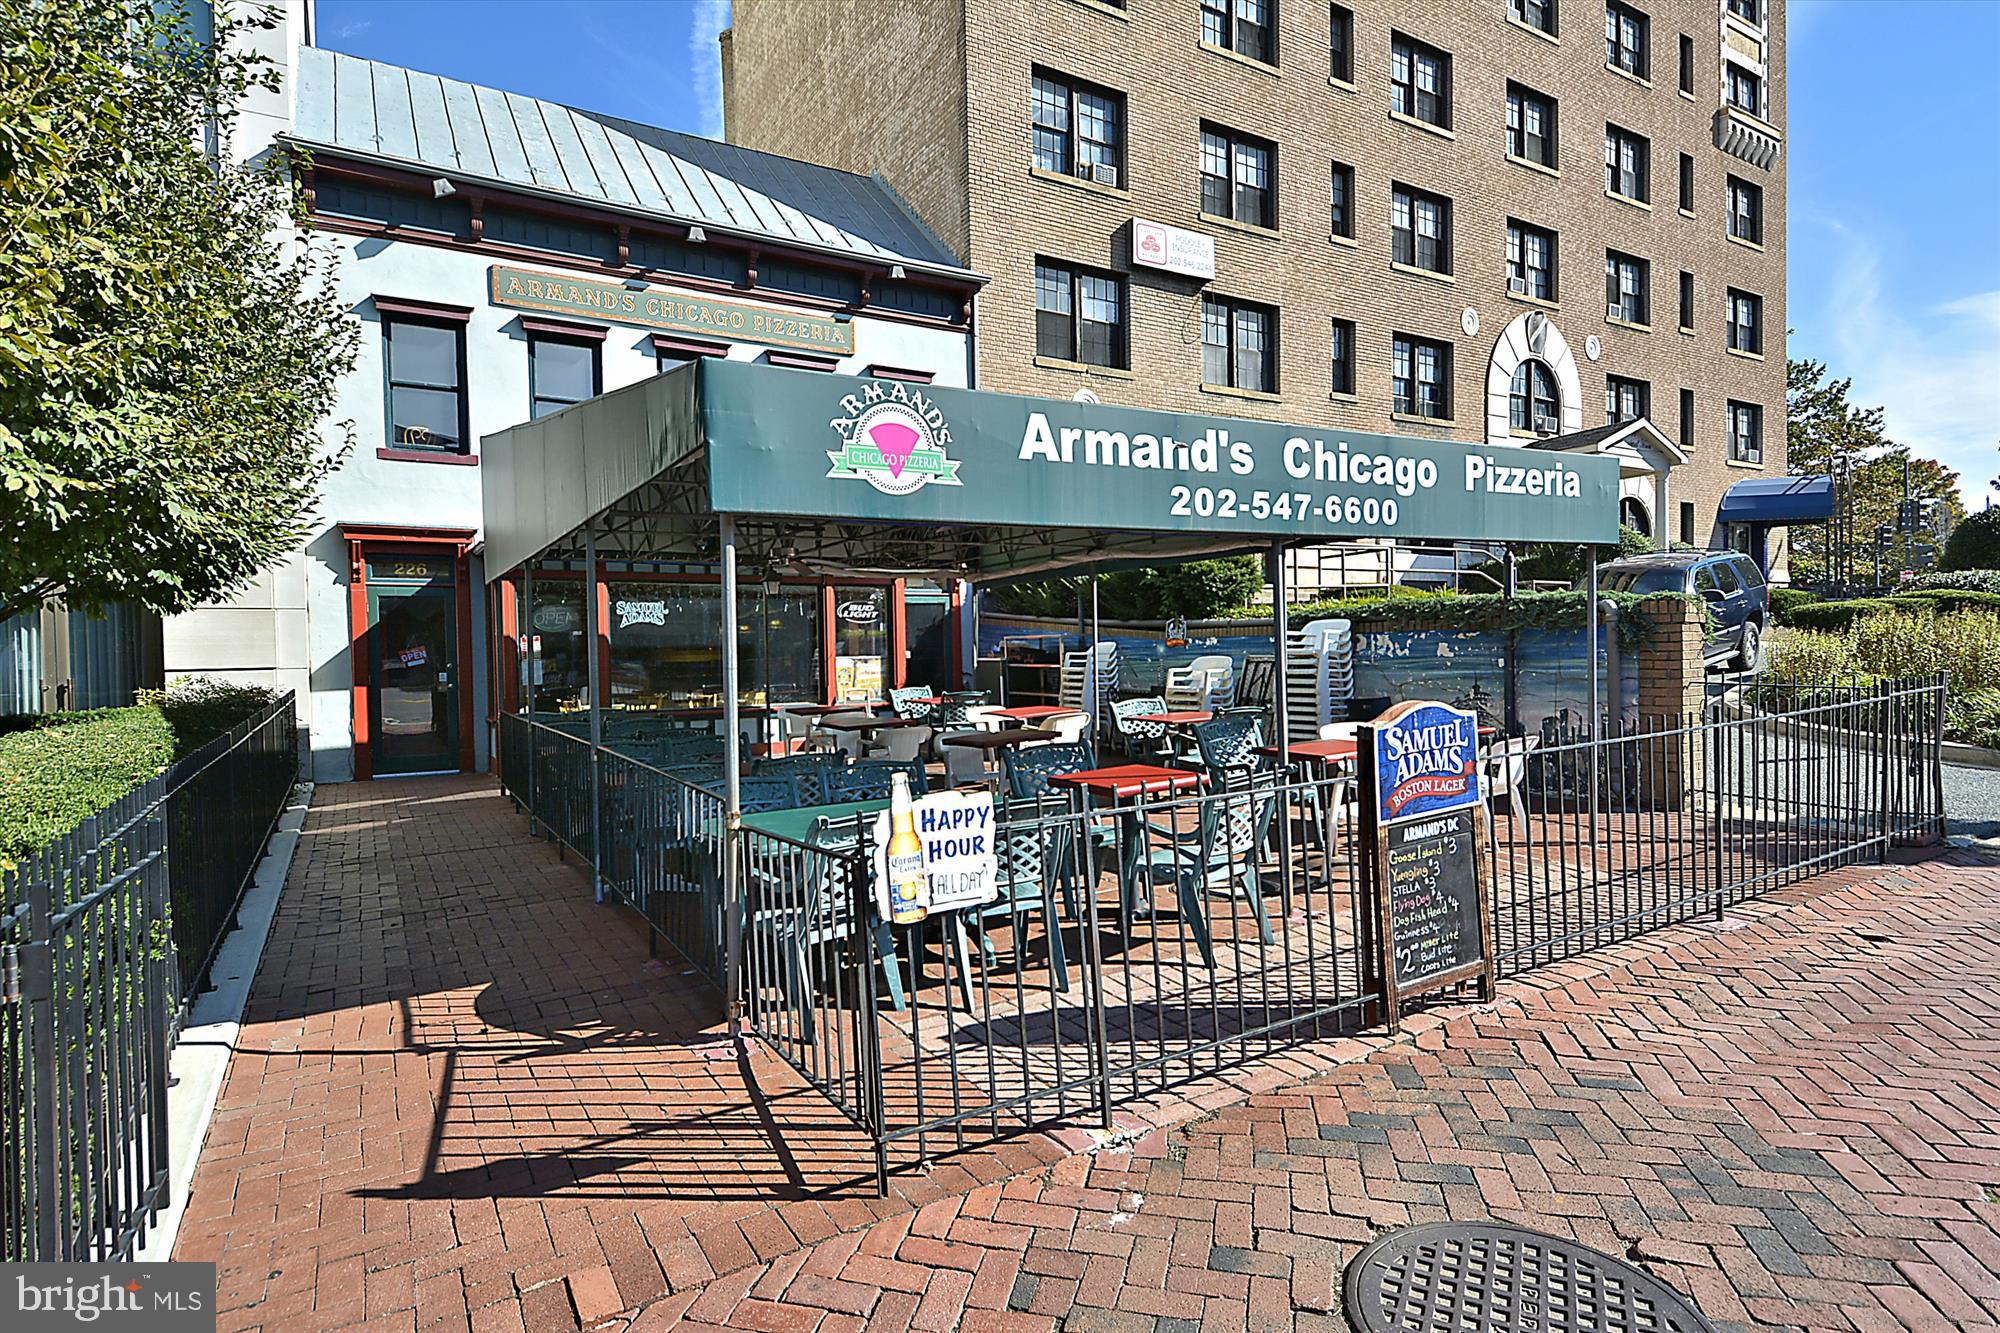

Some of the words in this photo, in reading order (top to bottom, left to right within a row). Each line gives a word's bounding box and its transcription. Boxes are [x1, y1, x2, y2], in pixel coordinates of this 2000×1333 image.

[506, 276, 636, 313] ARMAND'S
[645, 298, 745, 329] CHICAGO
[753, 314, 846, 344] PIZZERIA
[829, 380, 953, 447] ARMAND'S
[851, 450, 898, 466] CHICAGO
[899, 454, 939, 469] PIZZERIA
[1018, 412, 1255, 475] Armand's
[1282, 437, 1438, 497] Chicago
[1464, 454, 1581, 498] Pizzeria
[1169, 485, 1398, 526] 202-547-6600
[394, 563, 427, 576] 226
[615, 600, 669, 616] SAMUEL
[843, 610, 879, 619] LIGHT
[848, 604, 875, 612] BUD
[619, 613, 666, 629] ADAMS
[401, 650, 427, 662] OPEN
[1385, 719, 1469, 761] SAMUEL
[1393, 745, 1464, 788] ADAMS
[1392, 780, 1432, 808] BOSTON
[1434, 777, 1466, 792] LAGER
[921, 805, 990, 833] HAPPY
[1403, 820, 1447, 843] ARMAND'S
[1447, 817, 1460, 831] DC
[928, 834, 986, 863] HOUR
[1389, 849, 1416, 865] Goose
[937, 872, 958, 896] ALL
[959, 869, 985, 892] DAY
[1391, 865, 1429, 883] Yuengling
[1392, 881, 1421, 897] STELLA
[1393, 899, 1416, 913] Flying
[1416, 894, 1432, 907] Dog
[1393, 916, 1410, 928] Dog
[1410, 908, 1426, 924] Fish
[1427, 901, 1448, 918] Head
[1394, 925, 1430, 941] Guinness
[1420, 947, 1436, 962] Bud
